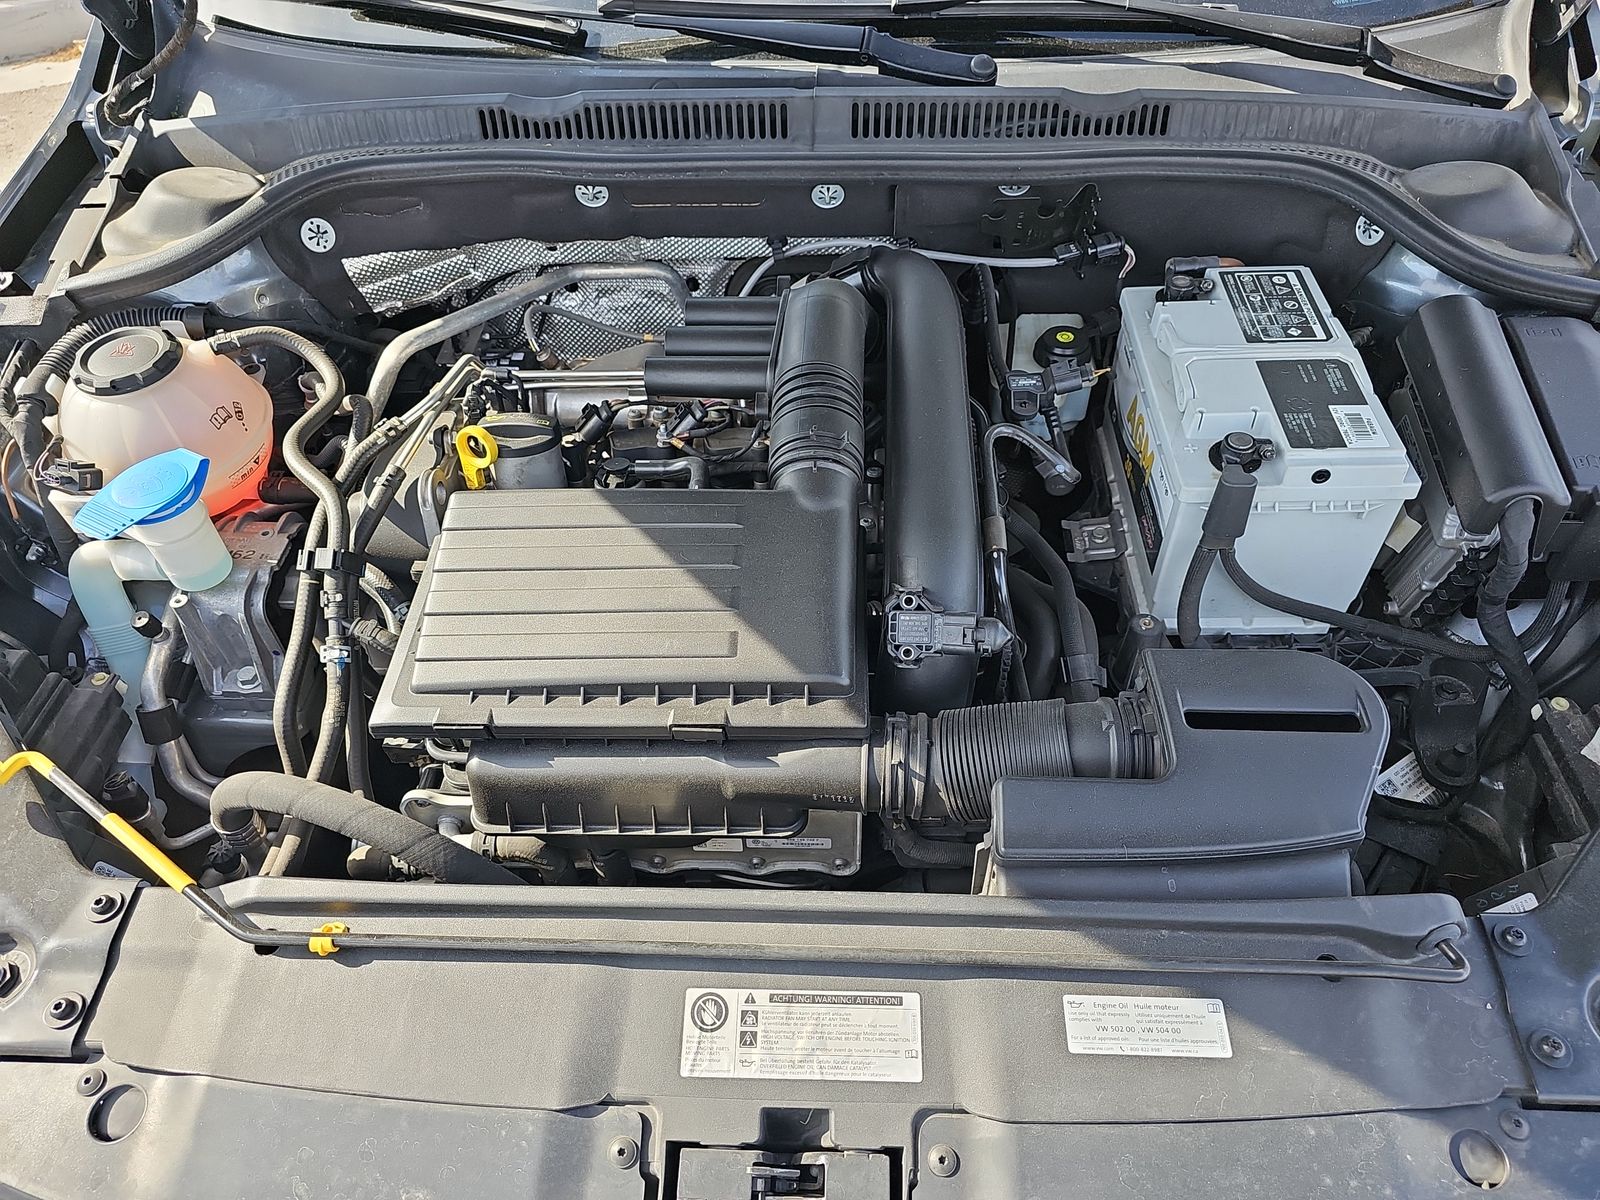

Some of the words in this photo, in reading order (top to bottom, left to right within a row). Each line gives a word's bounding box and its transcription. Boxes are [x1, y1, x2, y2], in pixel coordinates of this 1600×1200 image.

[1126, 395, 1155, 487] AGM
[241, 466, 254, 480] min
[772, 993, 813, 1003] ACHTUNG!
[814, 994, 854, 1004] WARNING!
[855, 996, 900, 1005] ATTENTION!
[1093, 1001, 1117, 1010] Engine
[1110, 1025, 1124, 1033] 502
